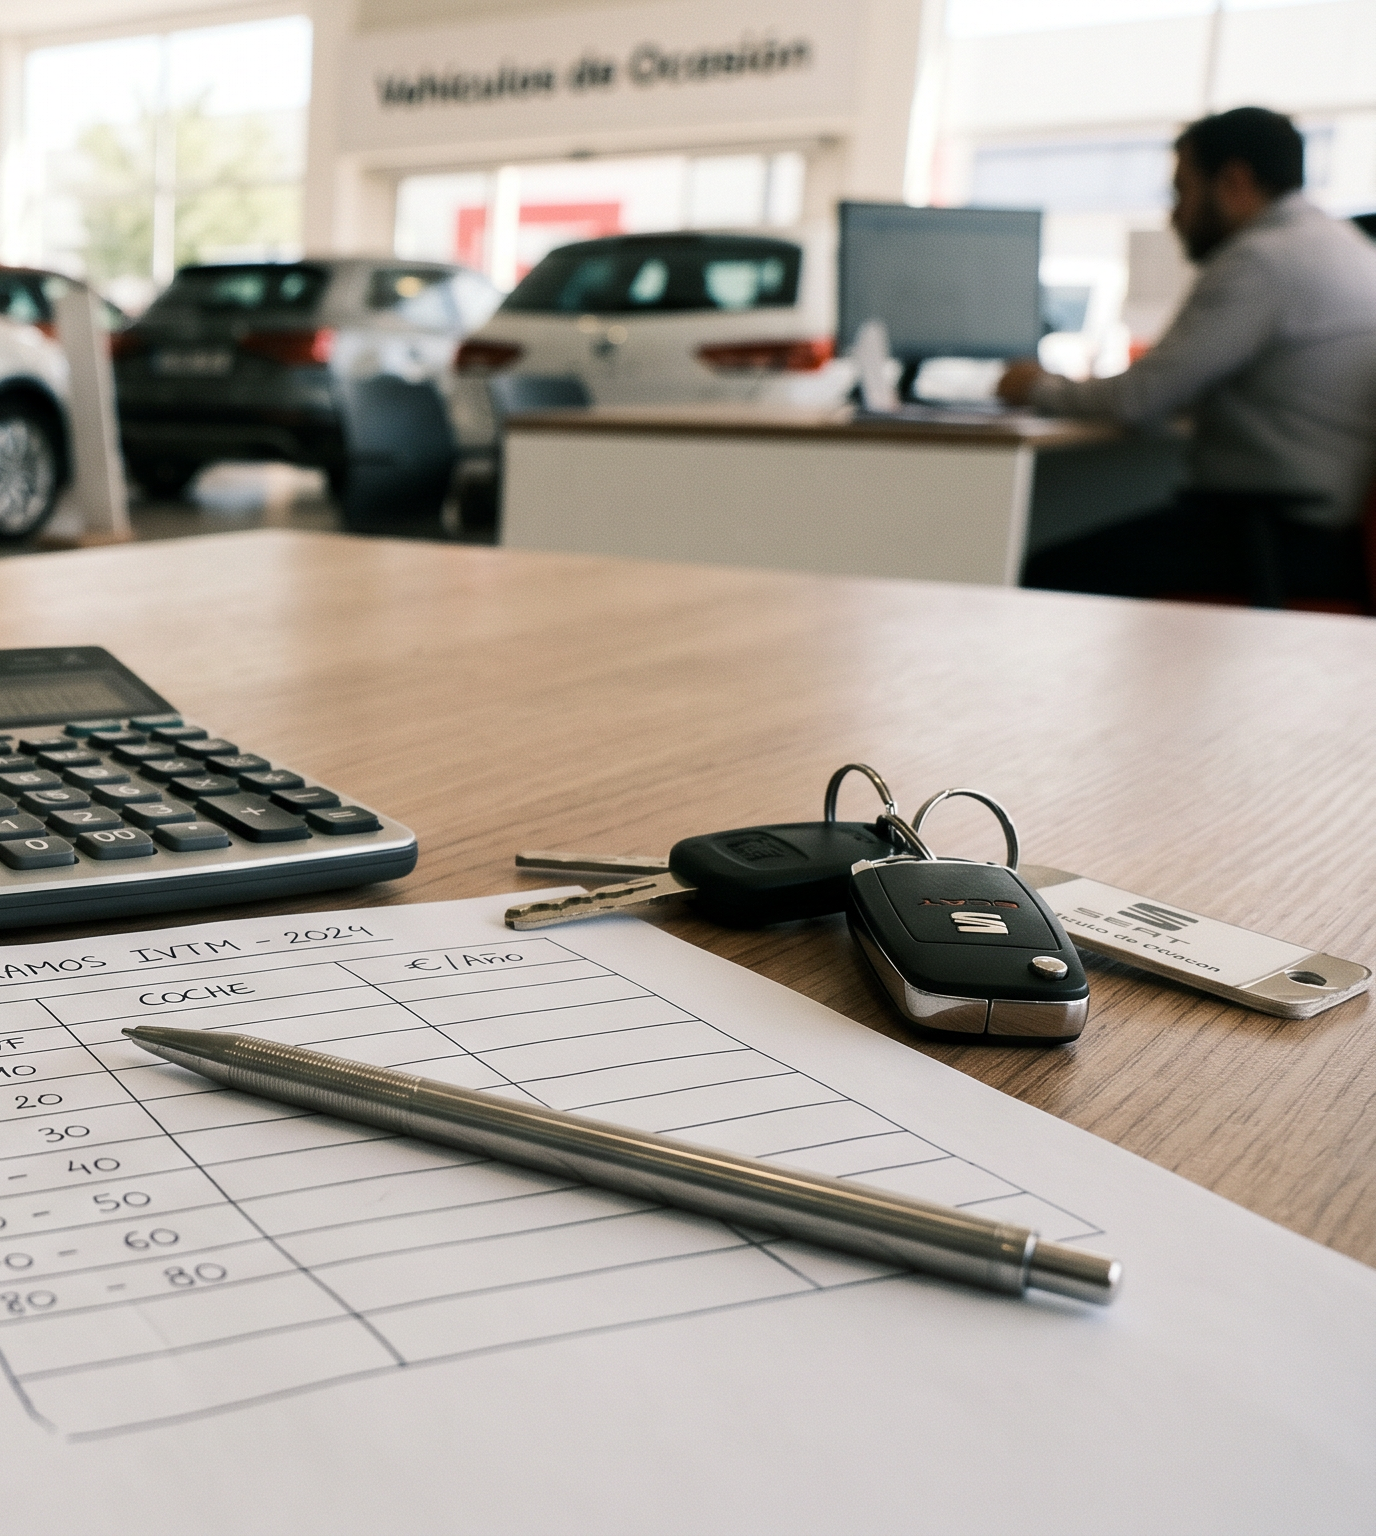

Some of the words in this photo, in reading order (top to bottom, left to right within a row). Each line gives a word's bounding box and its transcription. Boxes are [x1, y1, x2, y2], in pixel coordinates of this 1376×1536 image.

[74, 811, 101, 823] 2
[148, 805, 173, 816] 3
[1, 819, 19, 829] 1
[25, 839, 49, 850] 0
[94, 829, 136, 843] 00
[1074, 906, 1191, 946] SEAT
[130, 938, 241, 964] IVTM
[284, 924, 374, 945] 2024
[139, 981, 256, 1007] COCHE
[15, 1093, 63, 1110] 20
[38, 1125, 91, 1143] 30
[67, 1157, 120, 1175] 40
[92, 1191, 151, 1213] 50
[123, 1227, 180, 1251] 60
[163, 1261, 228, 1289] 80
